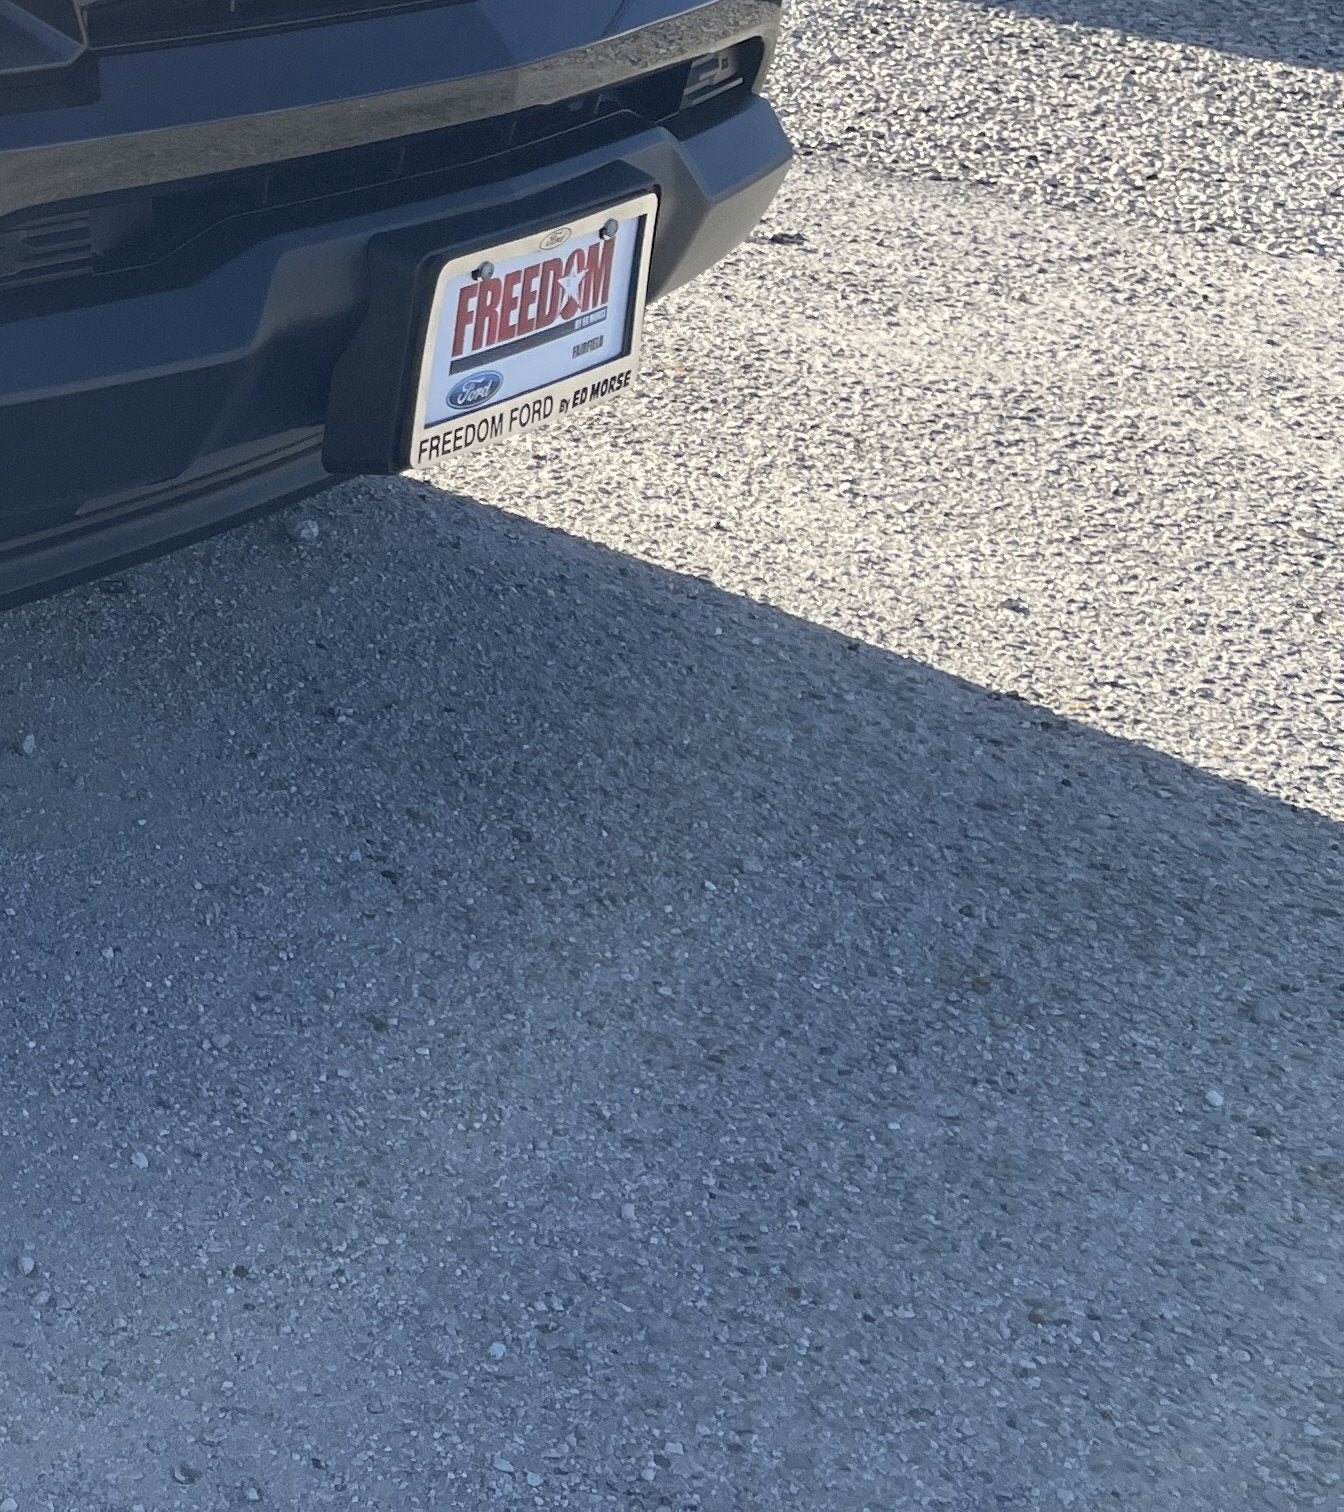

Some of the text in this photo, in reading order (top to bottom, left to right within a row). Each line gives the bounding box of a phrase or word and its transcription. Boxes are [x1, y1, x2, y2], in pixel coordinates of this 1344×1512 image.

[451, 238, 616, 358] FREEDOM
[418, 413, 503, 464] FREEDOM
[509, 395, 553, 432] FORD
[572, 386, 588, 409] ED
[589, 369, 632, 401] MORSE
[453, 374, 496, 407] Ford
